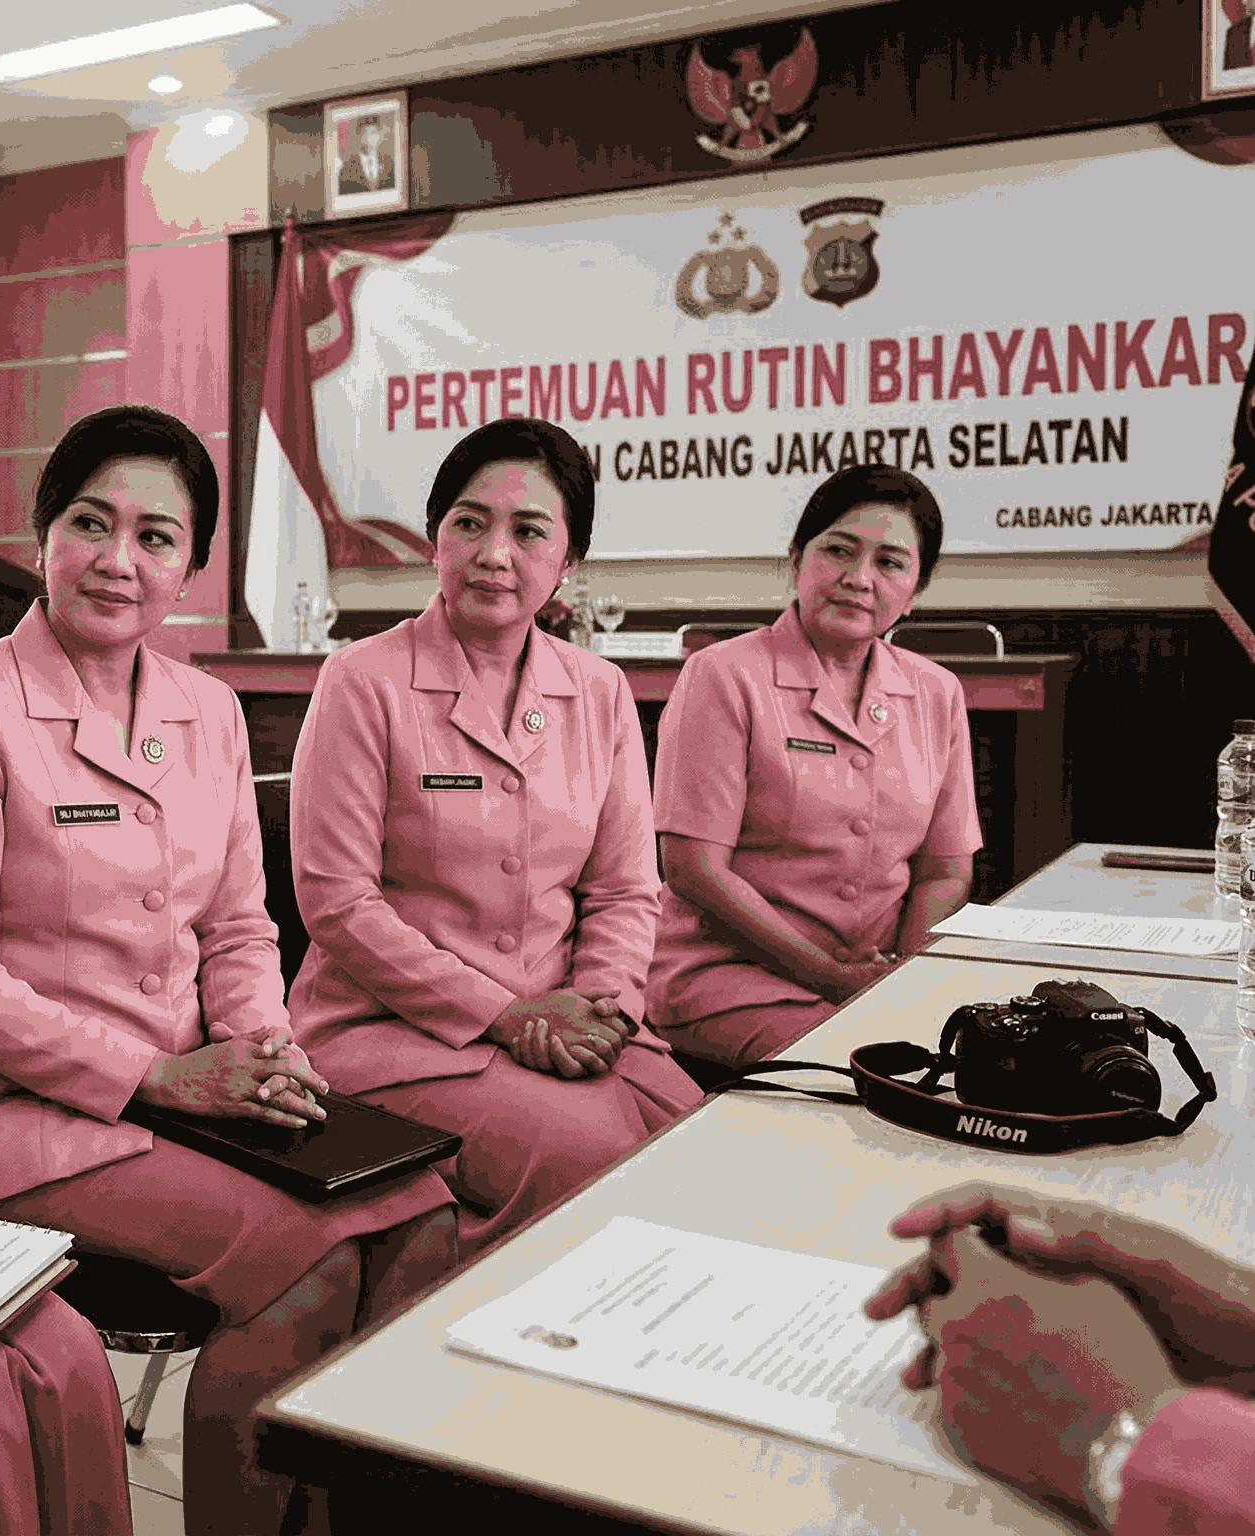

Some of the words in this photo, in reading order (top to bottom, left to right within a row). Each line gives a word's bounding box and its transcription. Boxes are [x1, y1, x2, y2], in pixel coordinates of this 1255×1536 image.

[386, 356, 666, 431] PERTEMUAN
[687, 341, 846, 415] RUTIN
[868, 312, 1255, 404] BHAYANKAR
[614, 433, 753, 482] CABANG
[766, 426, 935, 476] JAKARTA
[948, 415, 1130, 469] SELATAN
[995, 504, 1093, 528] CABANG
[1100, 501, 1215, 527] JAKARTA
[956, 1115, 1028, 1143] Nikon
